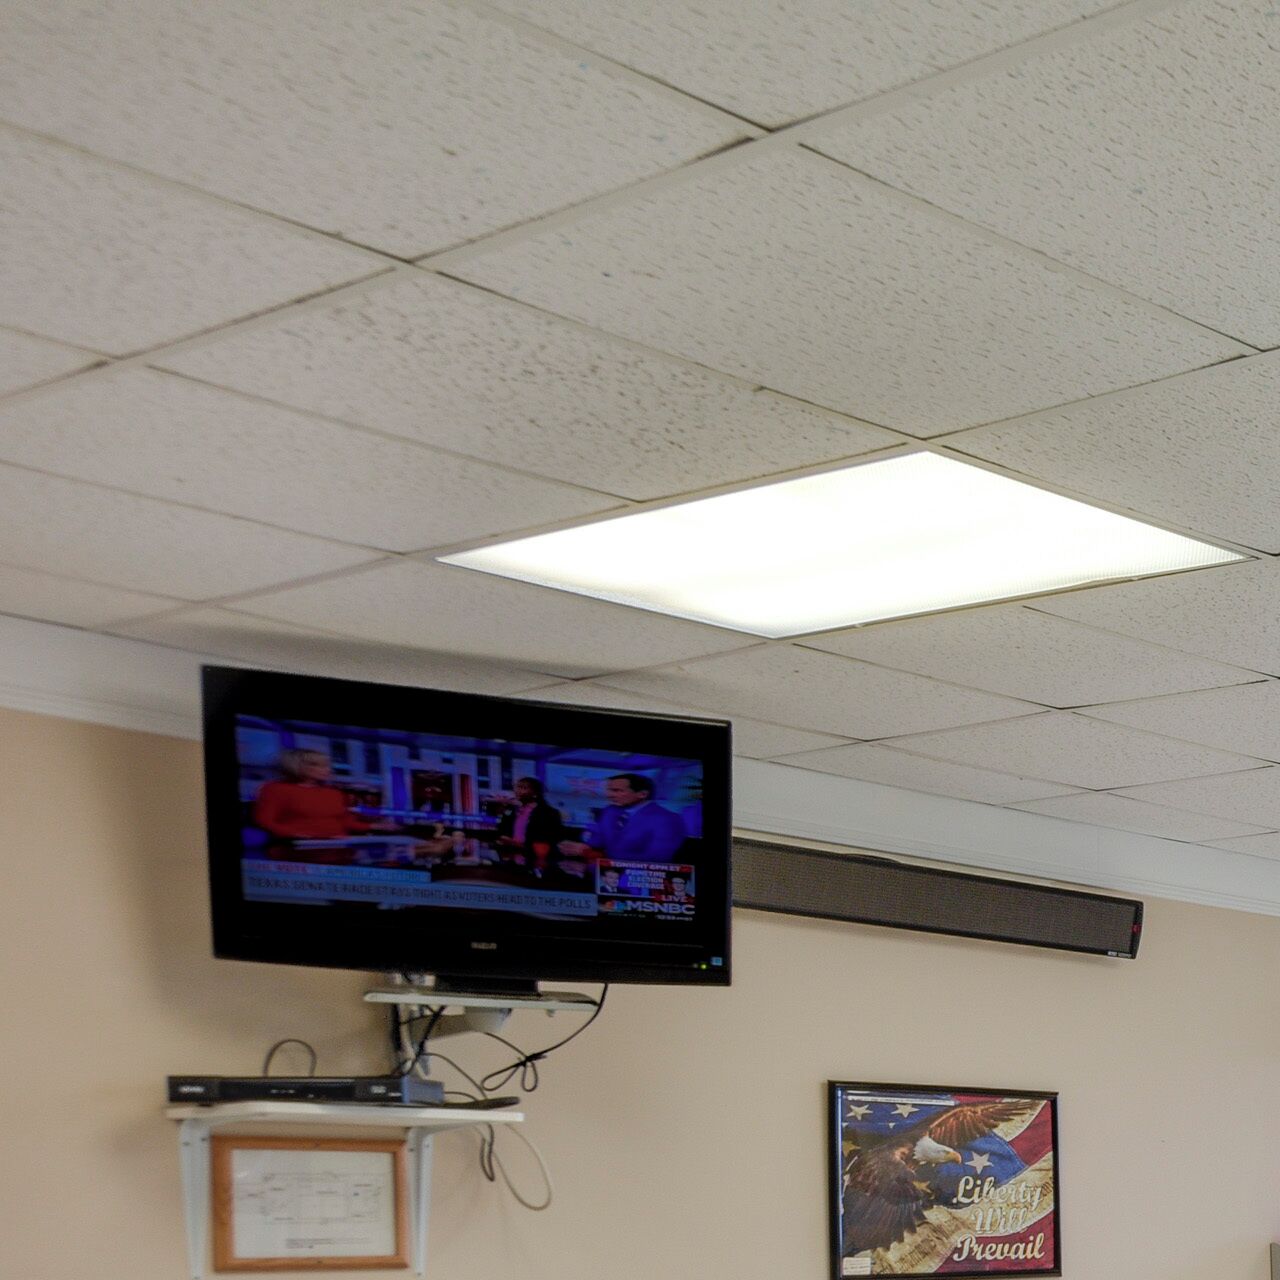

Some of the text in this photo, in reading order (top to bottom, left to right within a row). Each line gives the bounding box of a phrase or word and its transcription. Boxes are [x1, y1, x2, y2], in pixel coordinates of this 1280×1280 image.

[559, 896, 592, 909] POLLS
[625, 900, 695, 915] MSNBC
[661, 894, 688, 902] LIVE
[952, 1175, 1042, 1210] Liberty
[971, 1207, 1028, 1234] Will
[952, 1232, 1045, 1261] Prevail
